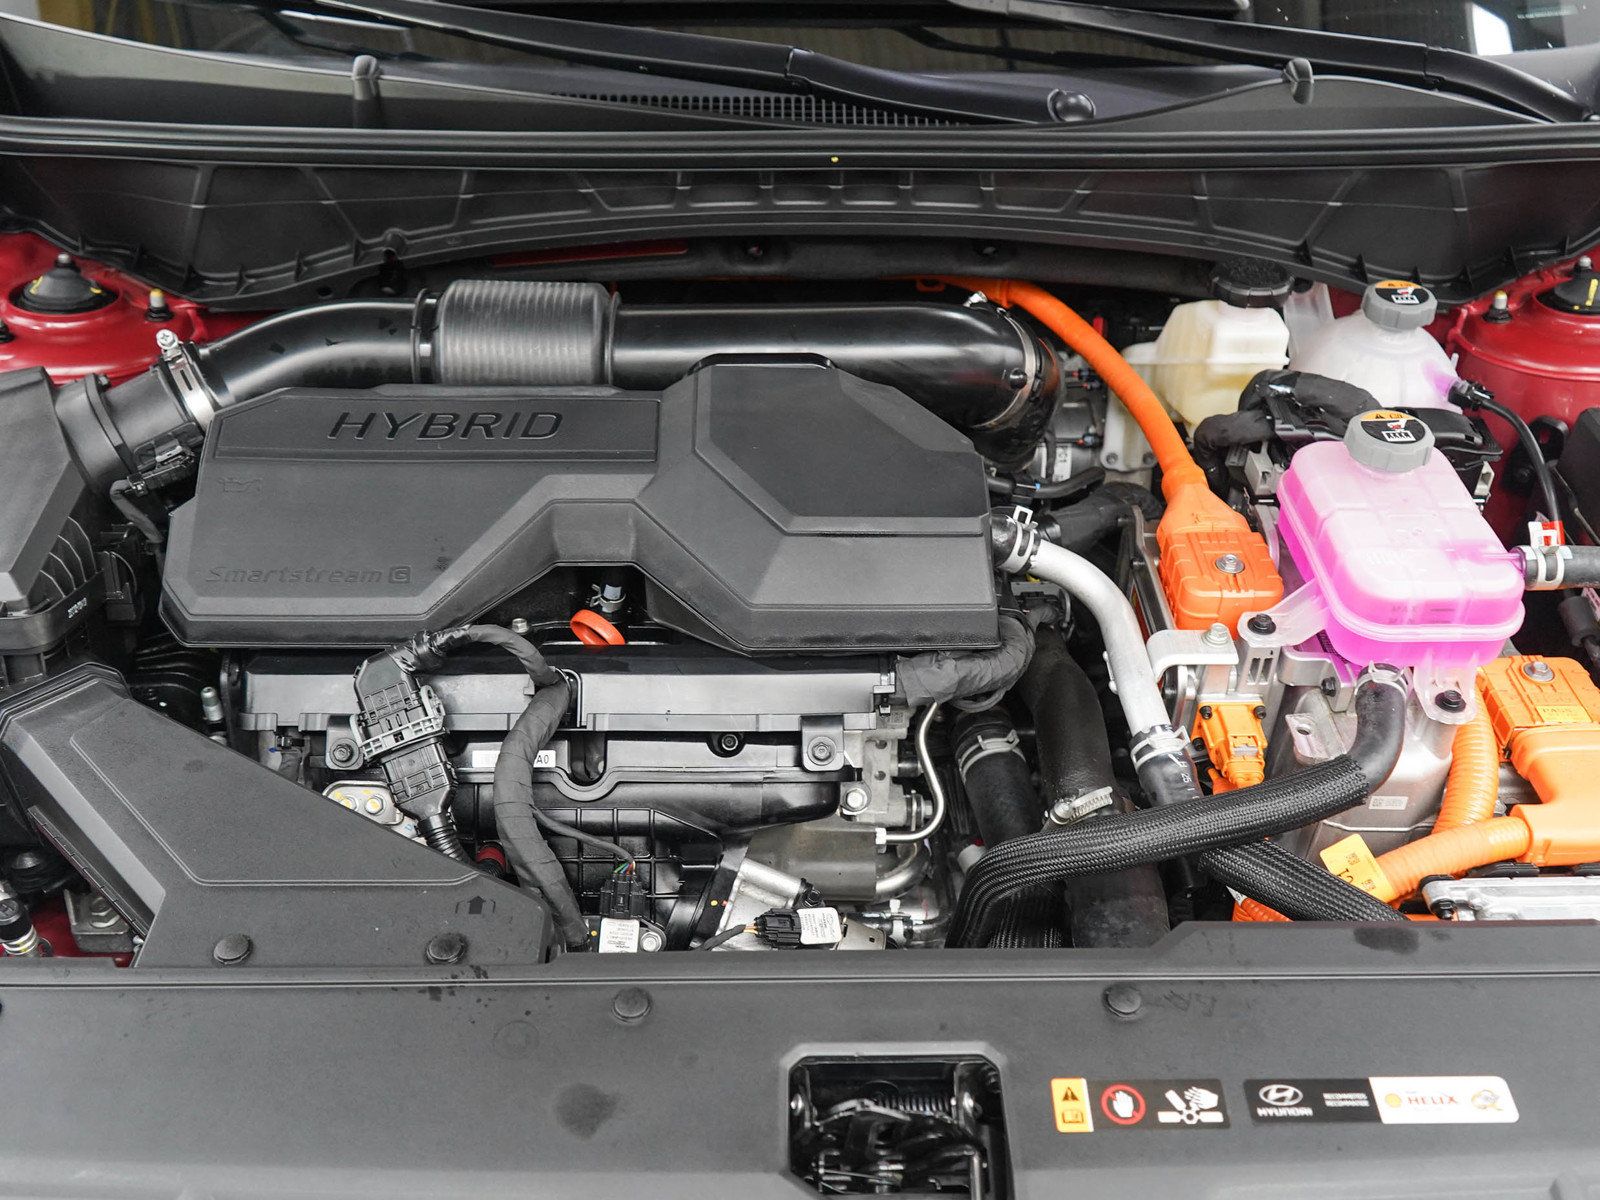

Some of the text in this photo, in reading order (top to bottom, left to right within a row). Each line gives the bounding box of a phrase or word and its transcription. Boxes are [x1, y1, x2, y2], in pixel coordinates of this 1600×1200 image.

[327, 412, 563, 440] HYBRID
[205, 566, 383, 583] Smartstream
[1408, 1096, 1459, 1105] HELIX
